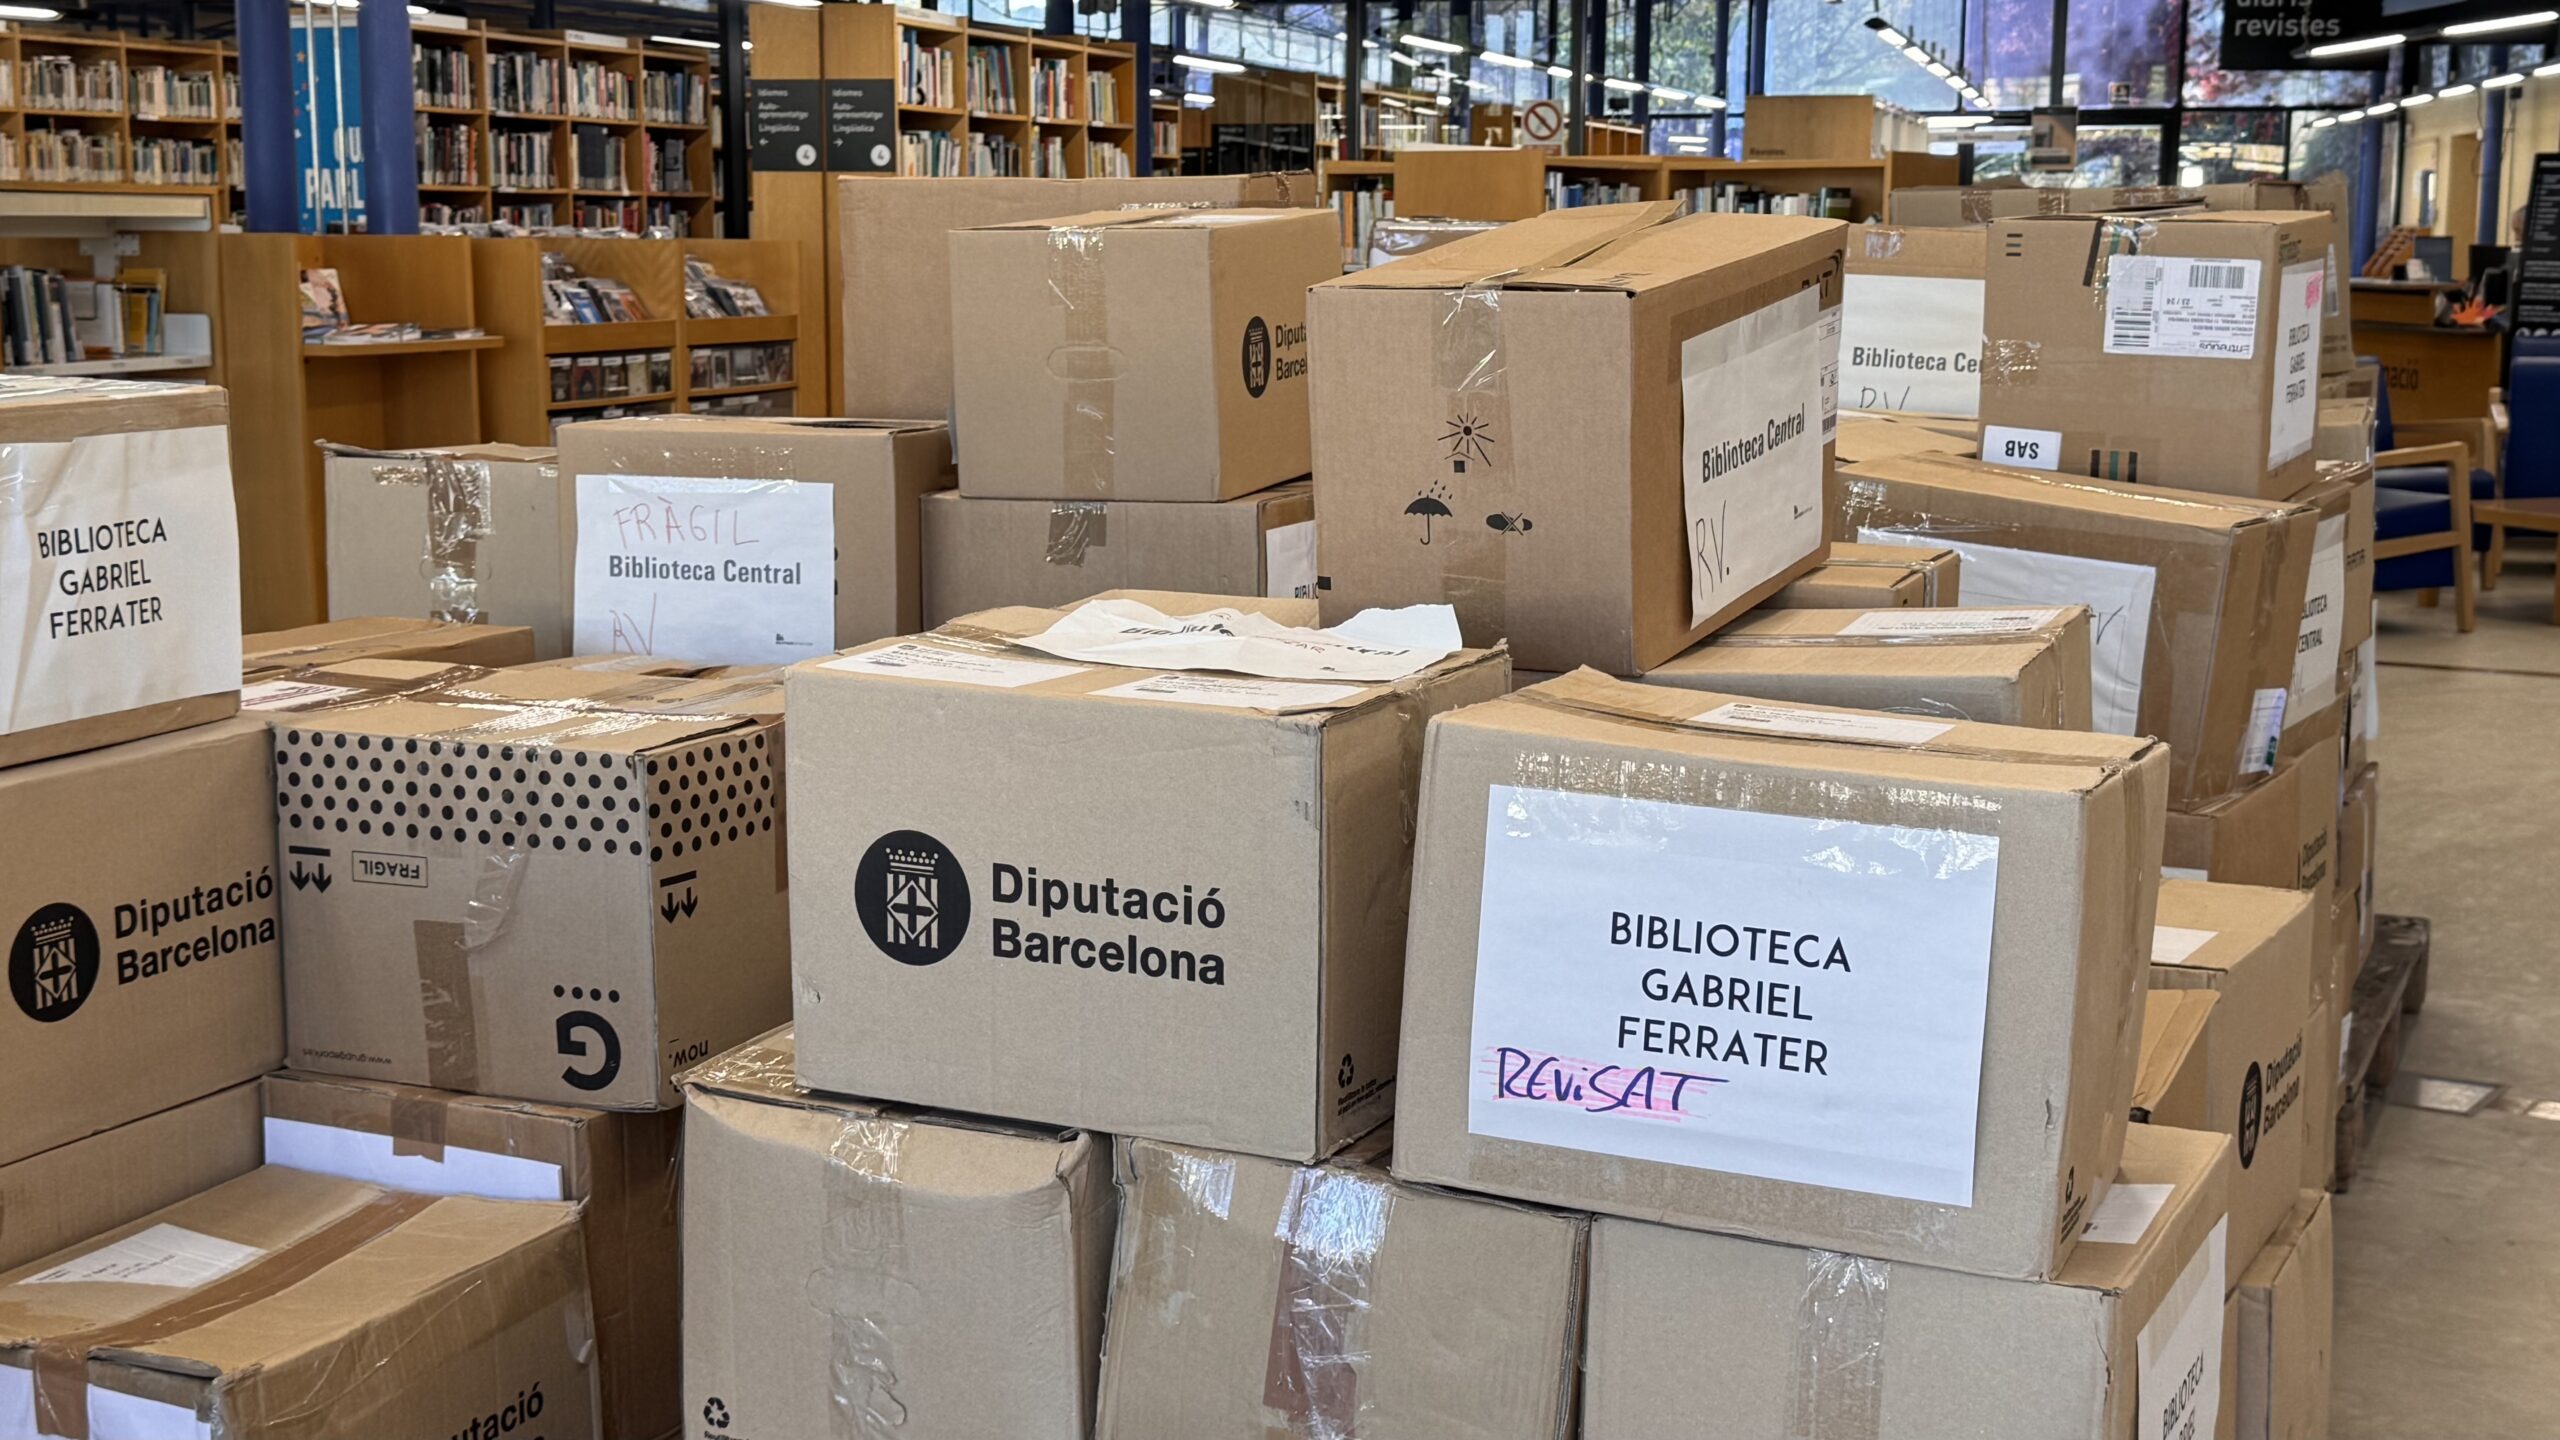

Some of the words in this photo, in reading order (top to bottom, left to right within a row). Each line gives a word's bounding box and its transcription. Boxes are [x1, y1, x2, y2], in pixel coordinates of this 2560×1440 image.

[2234, 12, 2341, 37] revistes
[1275, 321, 1306, 351] Diput
[1852, 346, 1947, 372] Biblioteca
[1702, 433, 1764, 483] Biblioteca
[1767, 402, 1805, 451] Central
[2004, 440, 2040, 460] SAB
[38, 517, 168, 559] BIBLIOTECA
[59, 559, 152, 597] GABRIEL
[609, 555, 716, 582] Biblioteca
[723, 559, 802, 585] Central
[49, 596, 164, 640] FERRATER
[2297, 628, 2324, 654] CENTRAL
[359, 859, 421, 880] FRAGIL
[114, 865, 274, 940] Diputació
[992, 862, 1226, 930] Diputació
[117, 917, 276, 986] Barcelona
[992, 917, 1226, 986] Barcelona
[1611, 911, 1852, 973] BIBLIOTECA
[1641, 967, 1813, 1021] GABRIEL
[1617, 1015, 1828, 1077] FERRATER
